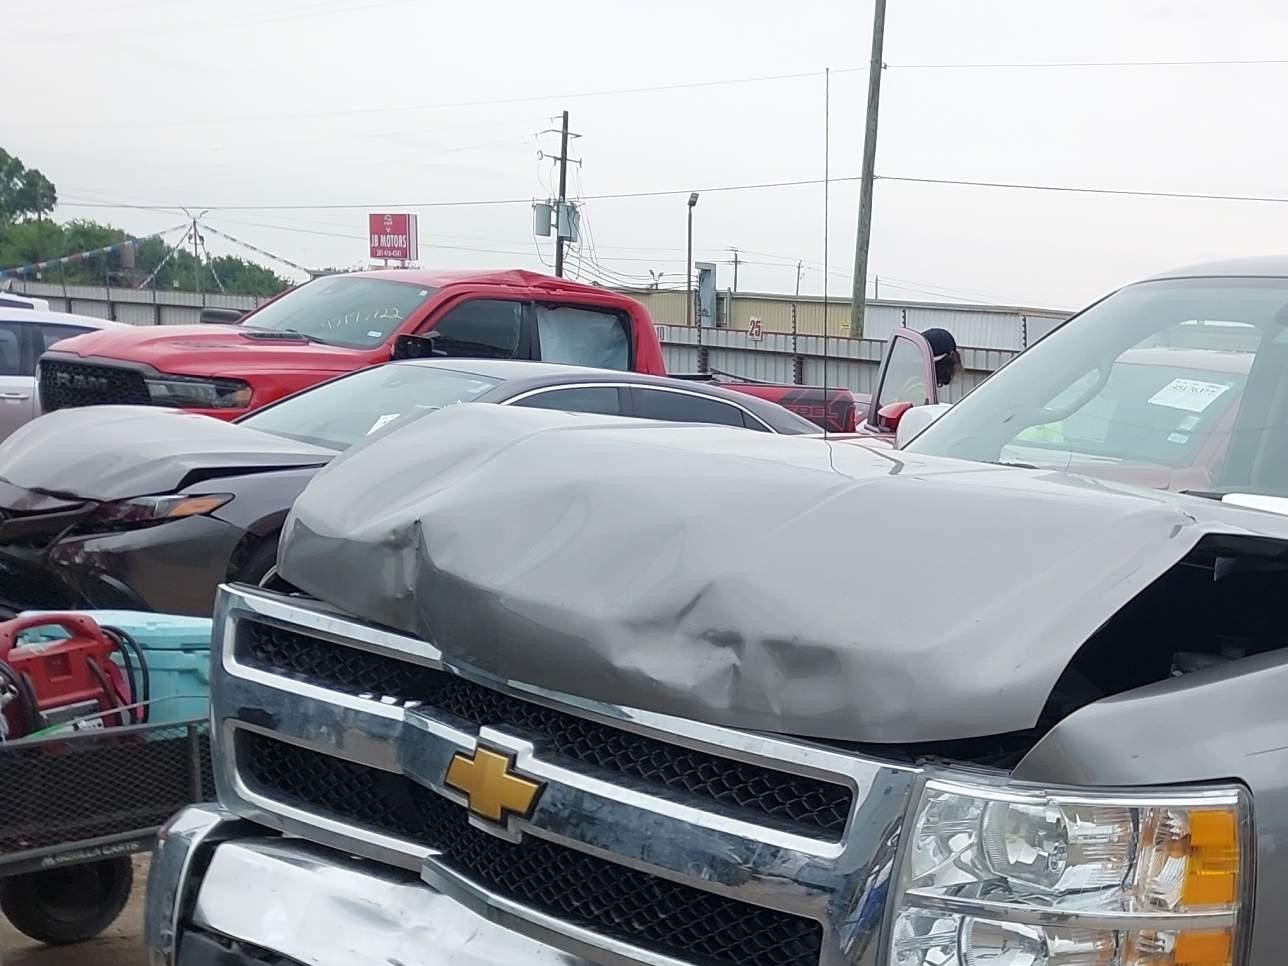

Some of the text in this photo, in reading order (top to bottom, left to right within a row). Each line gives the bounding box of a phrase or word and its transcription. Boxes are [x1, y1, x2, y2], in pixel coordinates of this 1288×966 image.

[371, 234, 407, 248] JB MOTORS
[749, 319, 761, 337] 25
